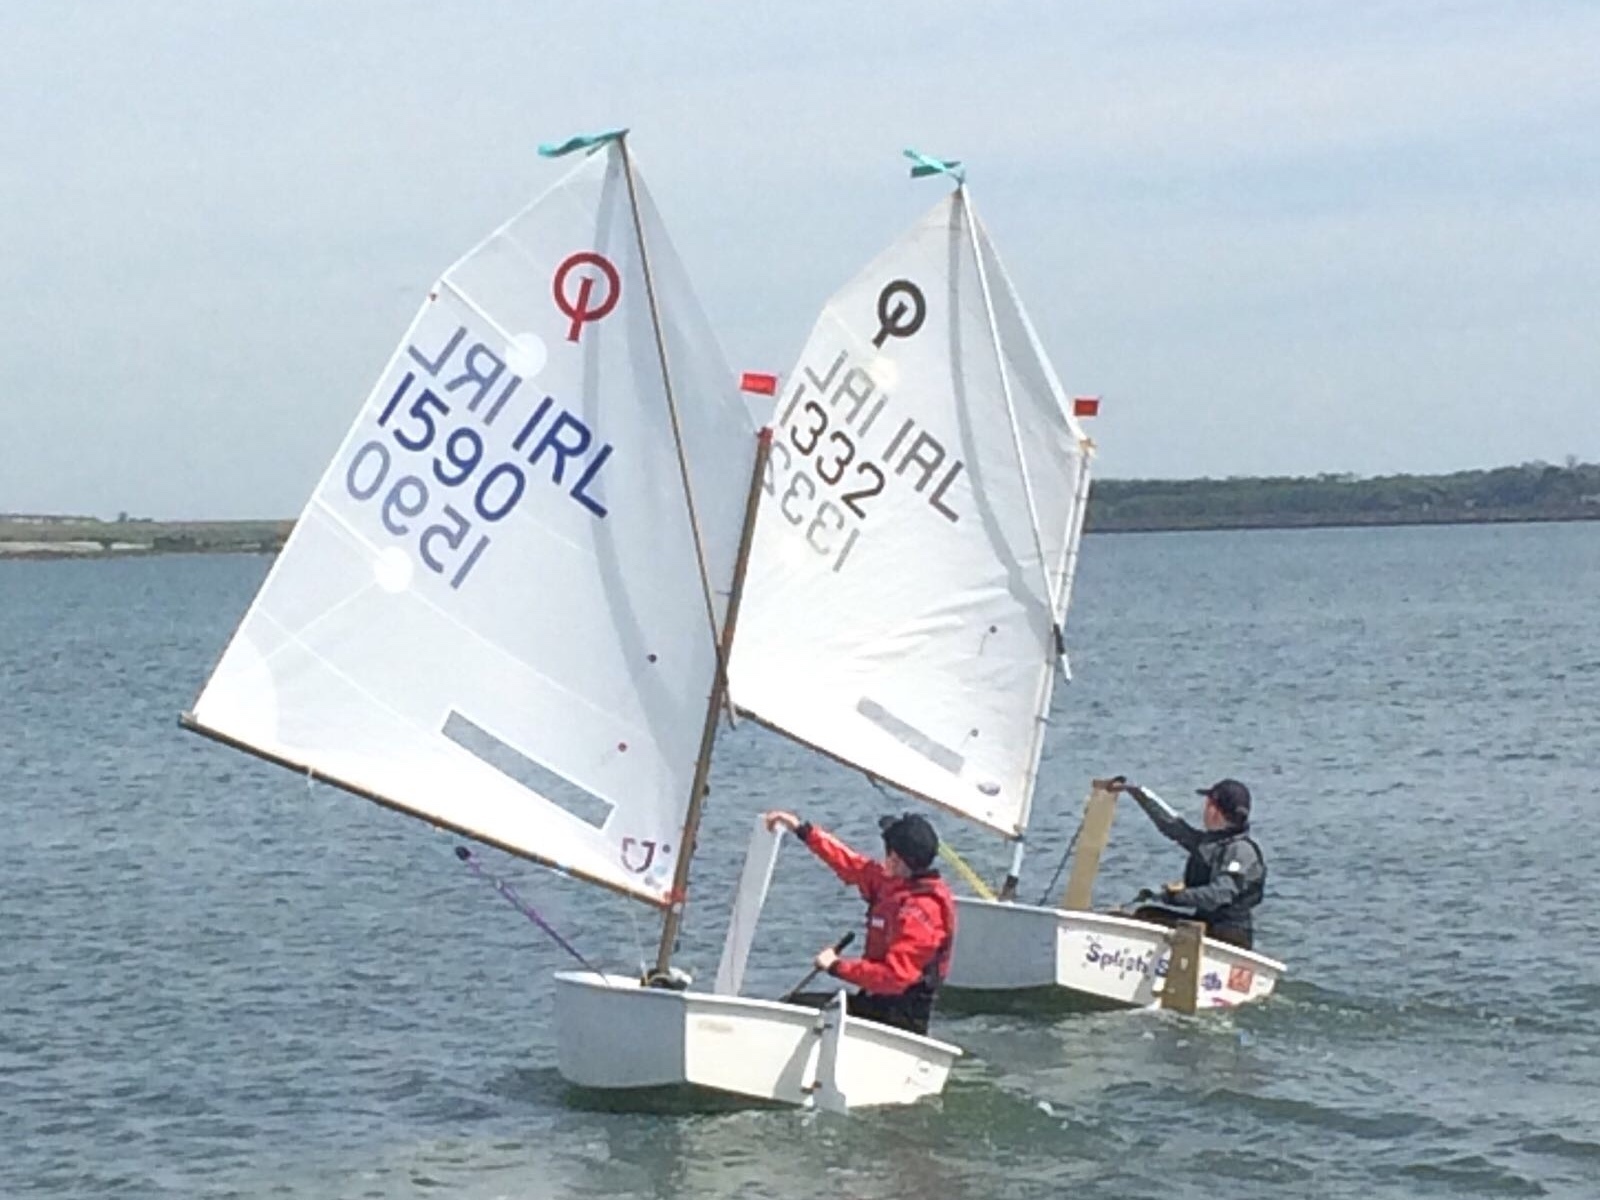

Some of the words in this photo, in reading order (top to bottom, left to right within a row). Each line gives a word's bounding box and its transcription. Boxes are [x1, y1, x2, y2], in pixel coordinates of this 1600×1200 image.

[377, 371, 526, 522] 1590
[511, 396, 614, 519] IRL
[779, 383, 886, 519] 1332
[881, 418, 964, 523] IRL
